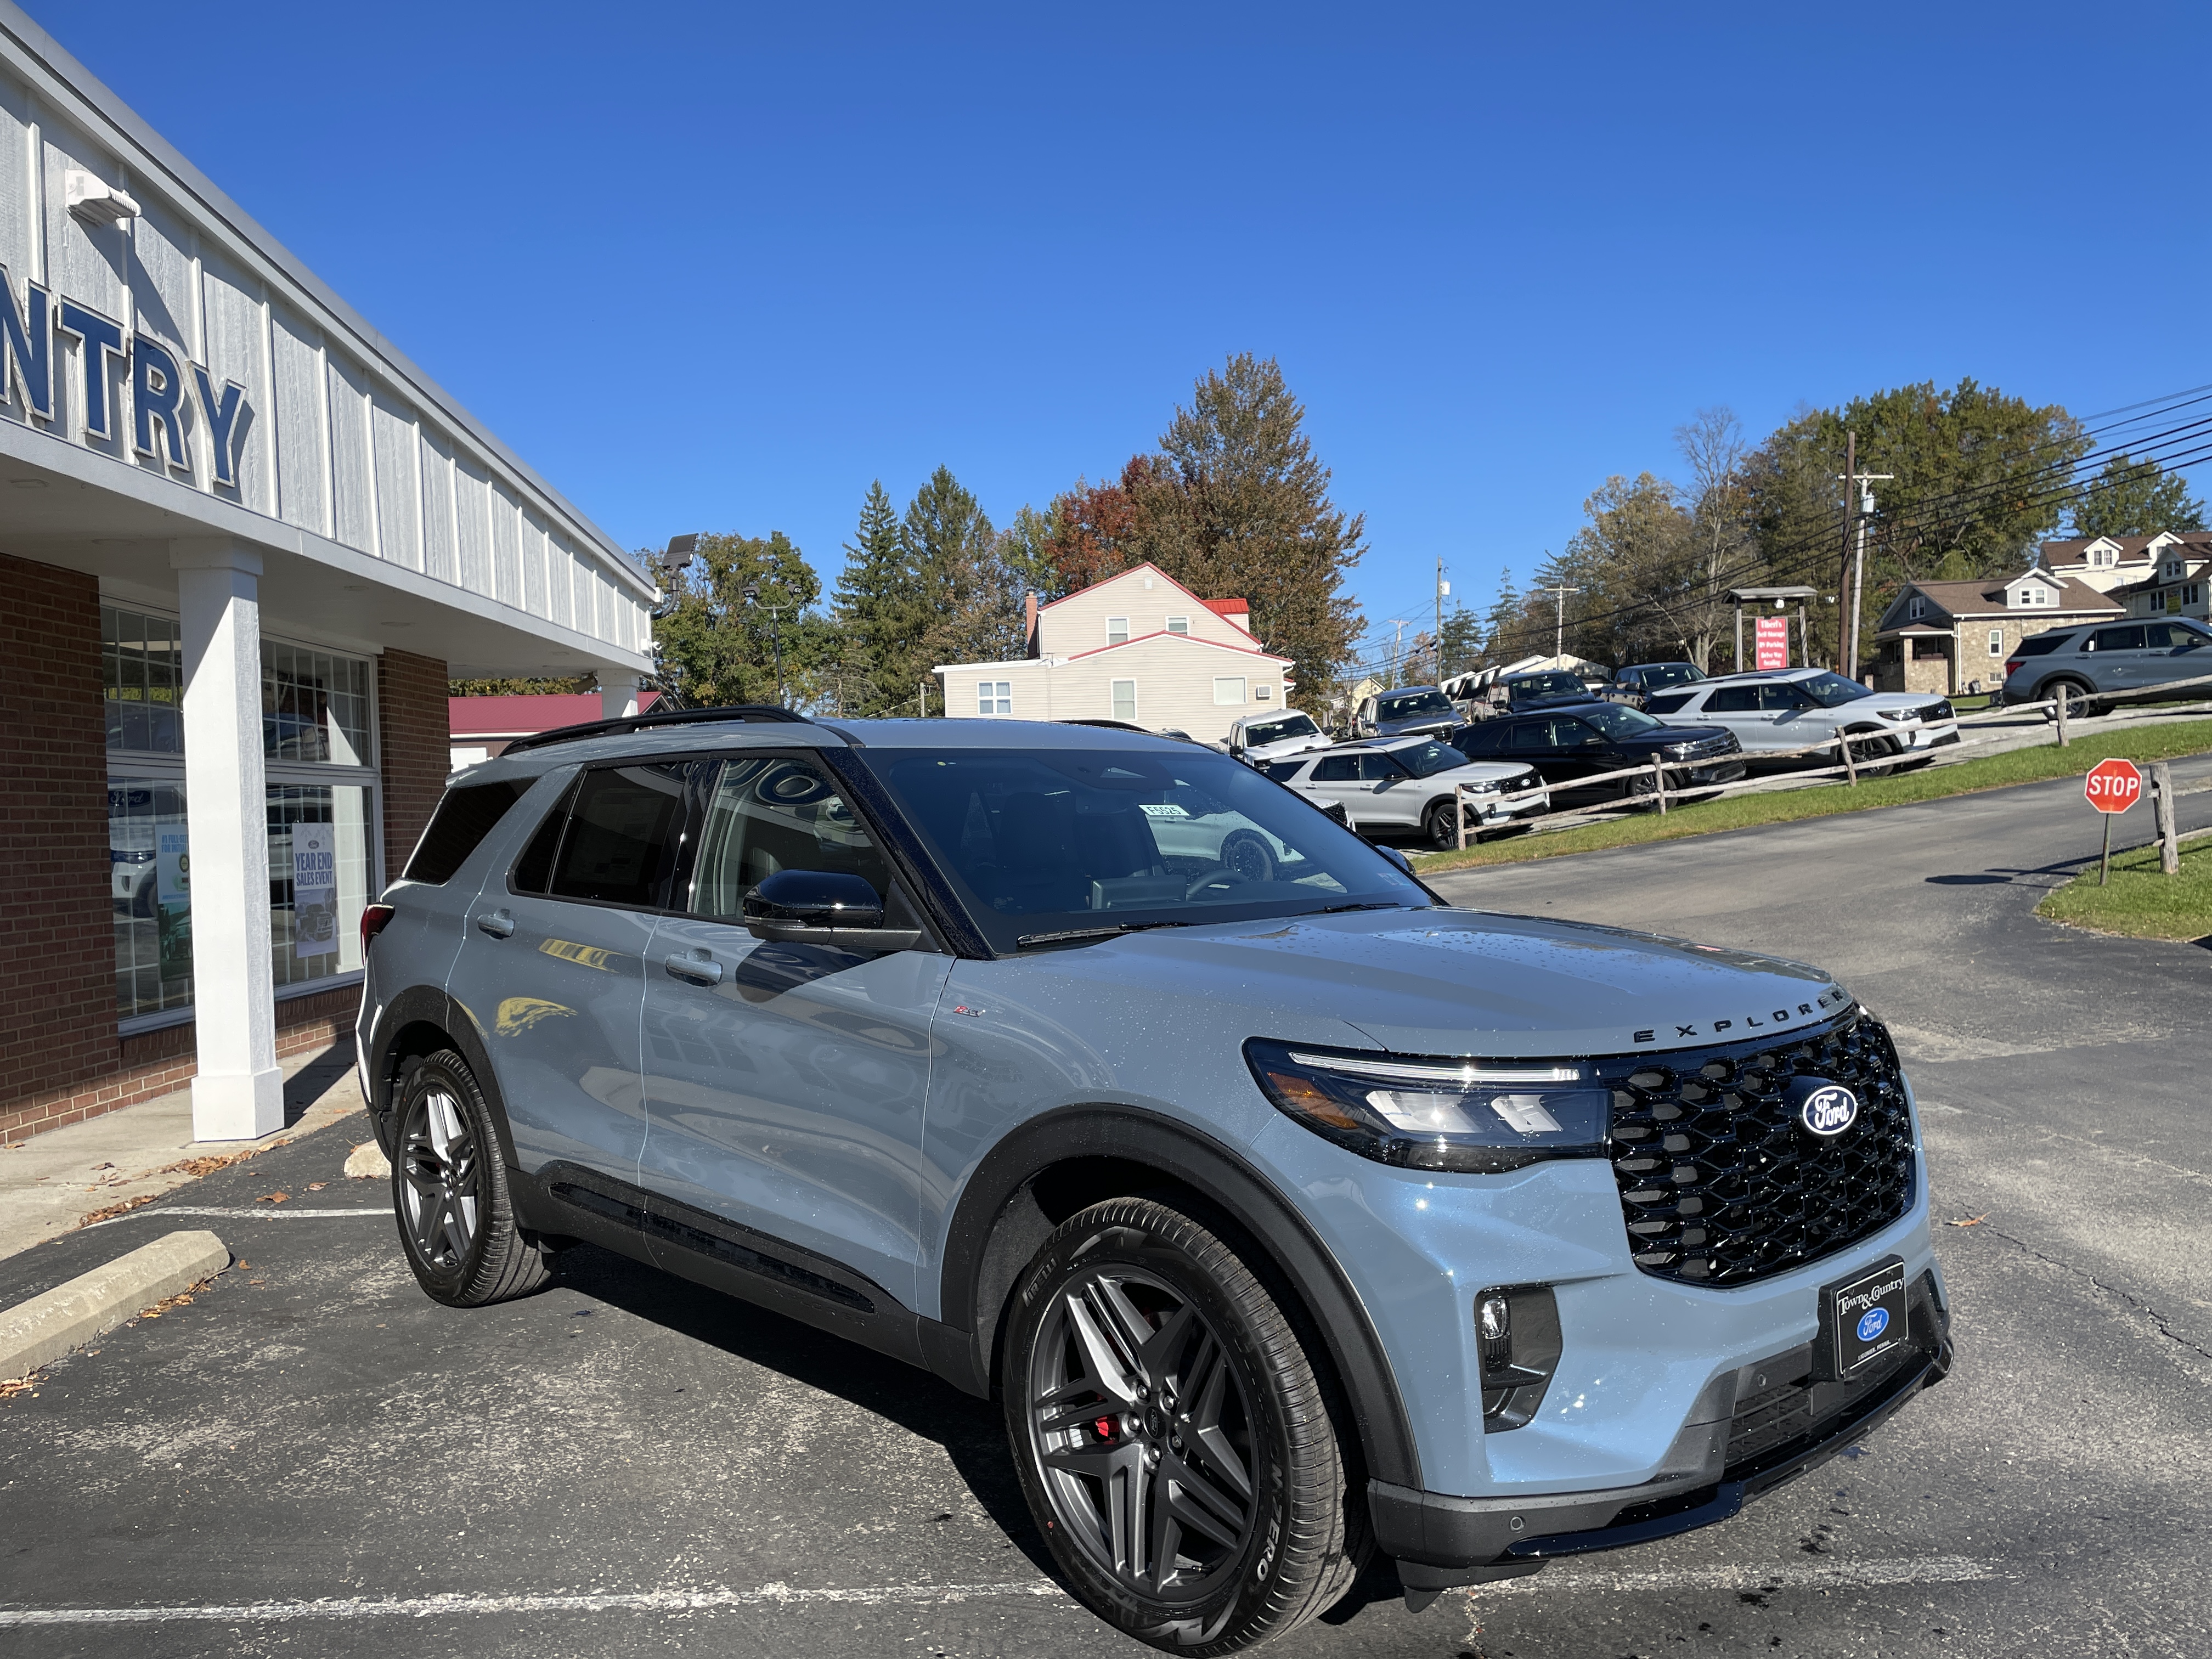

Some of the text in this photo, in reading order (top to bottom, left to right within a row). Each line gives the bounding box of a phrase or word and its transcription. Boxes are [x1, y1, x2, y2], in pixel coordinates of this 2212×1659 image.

[2089, 775, 2138, 797] STOP
[295, 852, 332, 871] YEAR END
[296, 871, 332, 886] SALES EVENT
[1633, 990, 1843, 1043] EXPLORER
[1814, 1092, 1850, 1129] Ford
[1022, 1254, 1057, 1307] PIRELLI
[1863, 1313, 1883, 1336] Ford
[1257, 1496, 1283, 1581] ZERO
